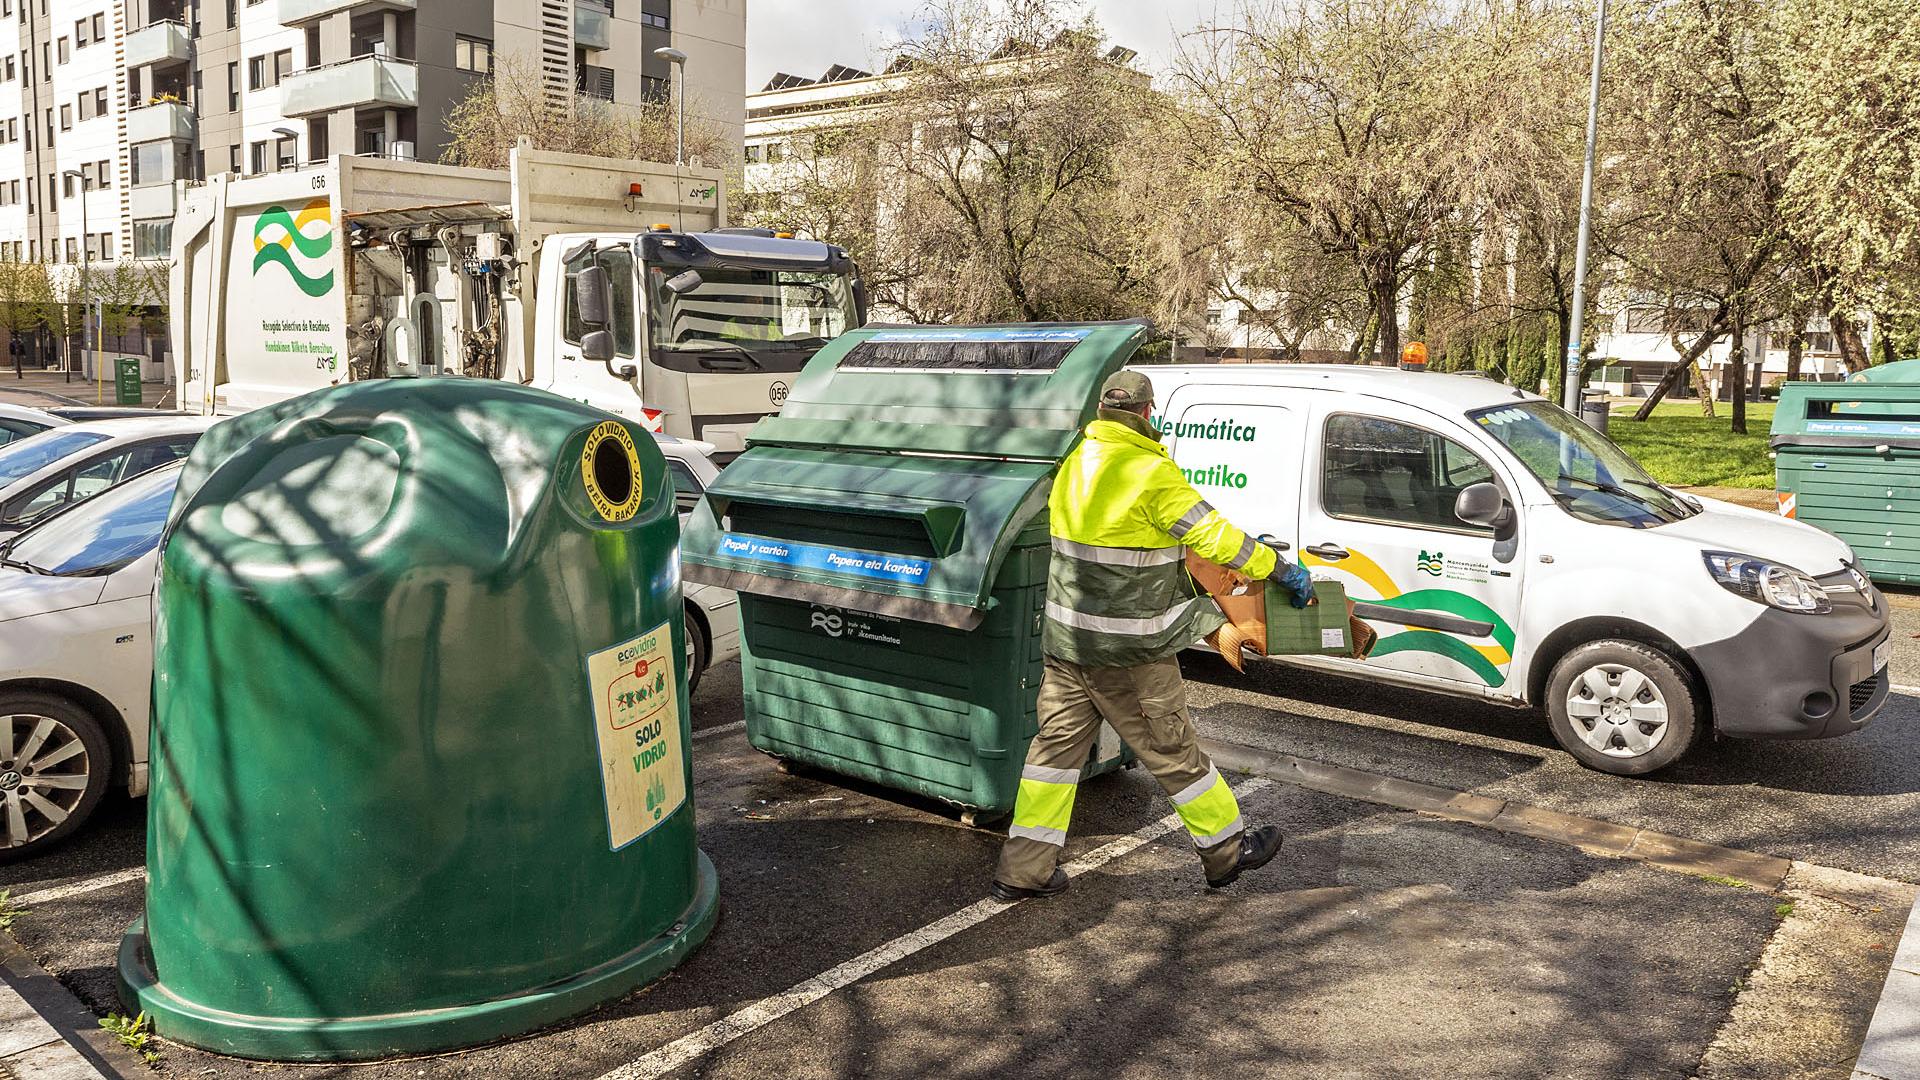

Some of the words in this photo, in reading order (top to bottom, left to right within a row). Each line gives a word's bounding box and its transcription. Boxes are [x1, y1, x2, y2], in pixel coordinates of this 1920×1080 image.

[311, 174, 326, 190] 056
[302, 320, 308, 332] de
[771, 386, 787, 402] 056
[1149, 415, 1256, 442] Neumática
[584, 424, 605, 462] SOLO
[605, 422, 633, 451] VIDRIO
[1180, 464, 1248, 489] matiko
[586, 483, 612, 519] BEIRA
[615, 468, 640, 521] BAKARRIK
[723, 538, 749, 553] Papel
[749, 544, 758, 555] y
[758, 545, 789, 557] cartón
[826, 553, 864, 568] Papera
[864, 559, 881, 571] eta
[883, 559, 924, 576] kartoia
[617, 635, 657, 662] ecovidrio
[635, 719, 661, 747] SOLO
[632, 739, 667, 773] VIDRIO
